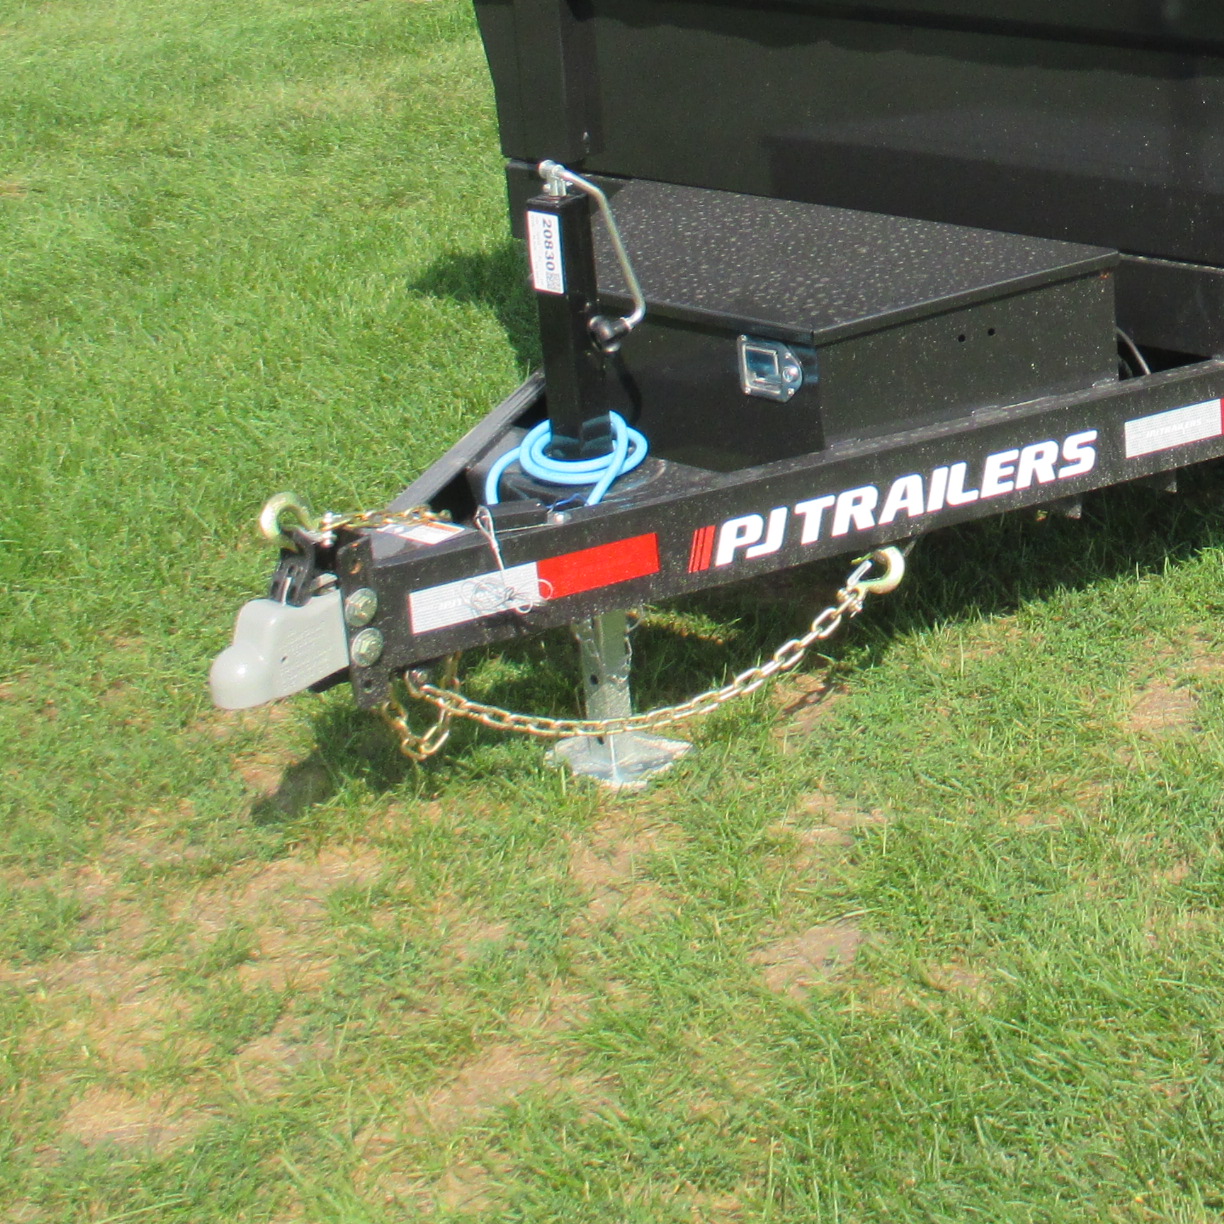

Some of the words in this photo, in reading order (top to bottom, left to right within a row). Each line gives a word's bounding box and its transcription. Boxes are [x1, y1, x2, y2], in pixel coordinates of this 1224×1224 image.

[542, 218, 555, 272] 20830
[715, 505, 790, 567] PJ
[795, 429, 1098, 546] TRAILERS
